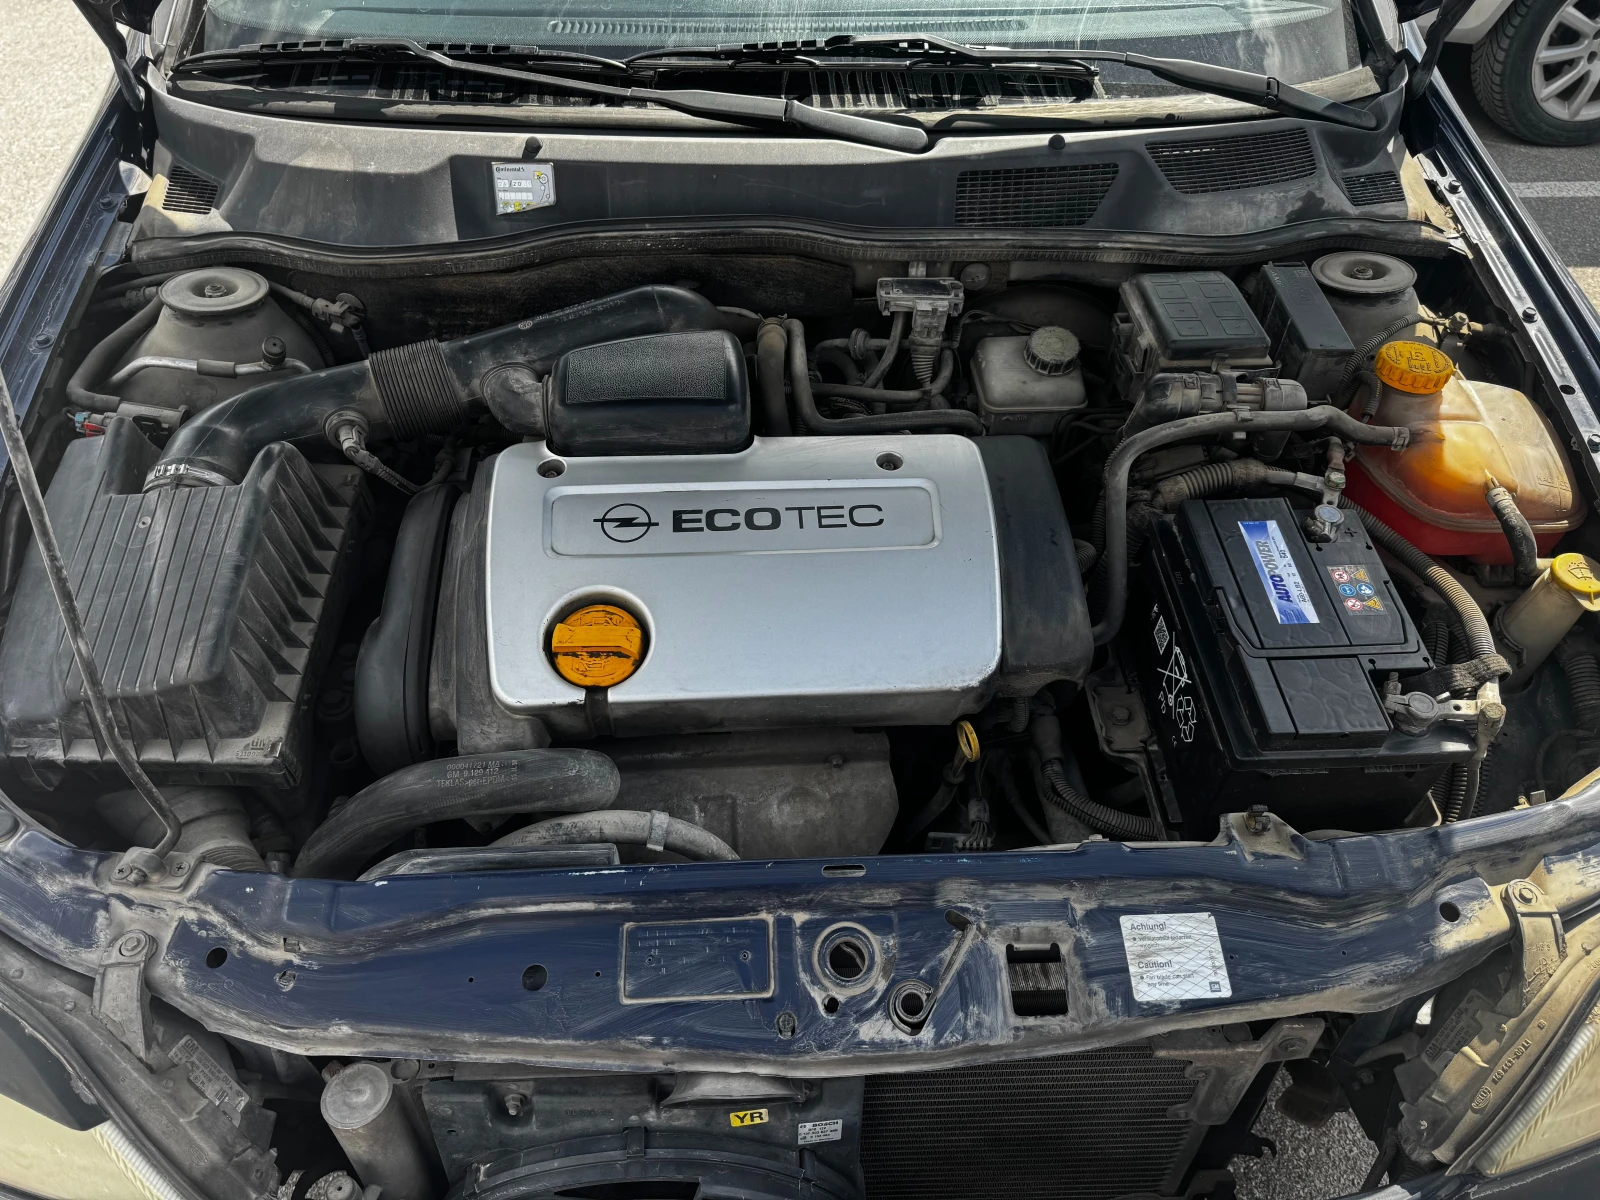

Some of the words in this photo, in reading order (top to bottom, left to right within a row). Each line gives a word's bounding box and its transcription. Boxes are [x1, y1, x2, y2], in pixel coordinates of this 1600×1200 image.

[672, 504, 884, 533] ECOTEC
[1255, 540, 1293, 603] AUTOPOWER
[1130, 922, 1167, 931] Achtung!
[1137, 960, 1173, 969] Caution!
[185, 1038, 199, 1054] GM
[733, 1111, 764, 1124] YR
